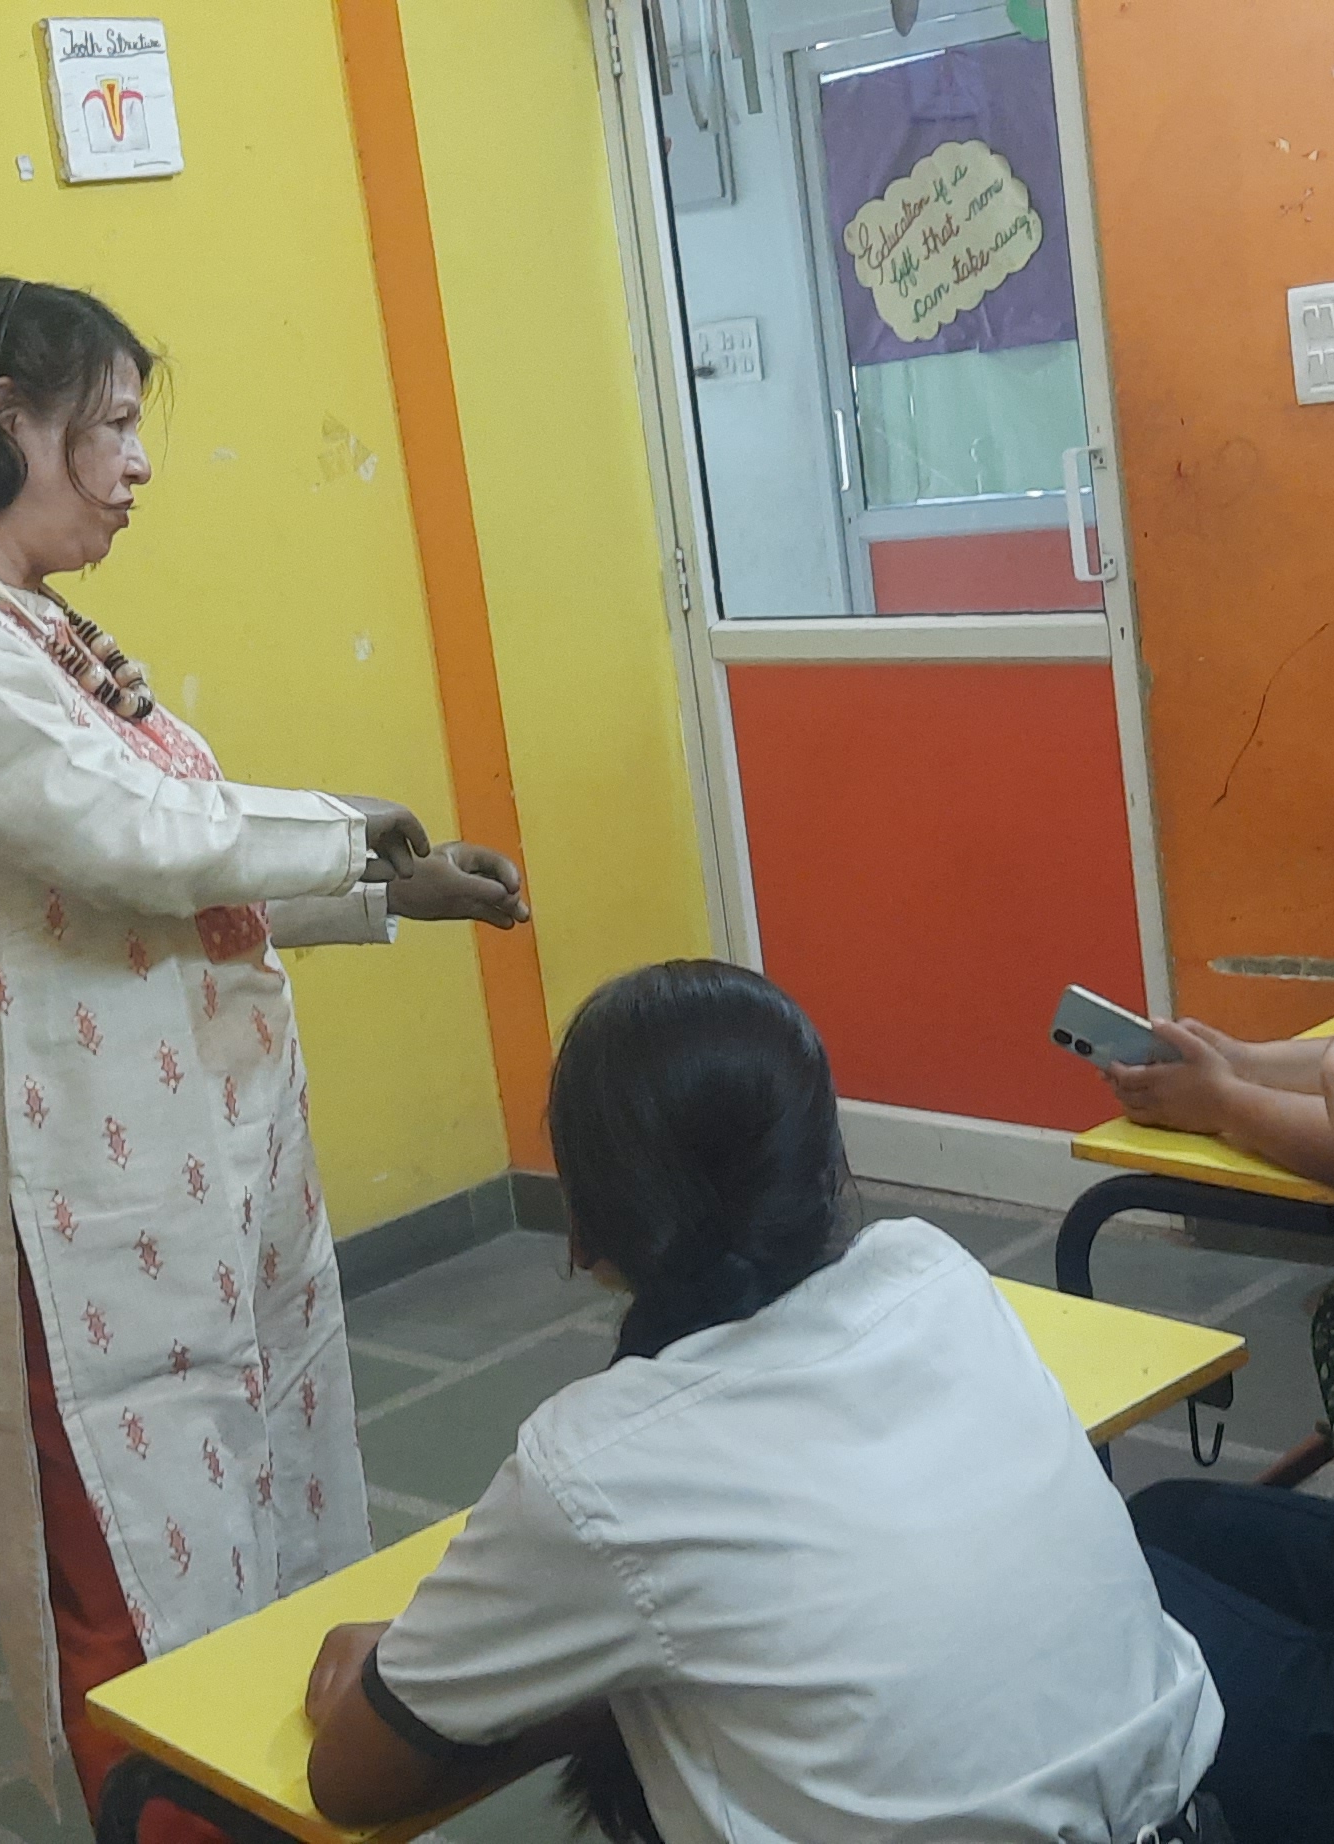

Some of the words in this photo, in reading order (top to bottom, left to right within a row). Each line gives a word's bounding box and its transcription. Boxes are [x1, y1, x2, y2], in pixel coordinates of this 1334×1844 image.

[60, 28, 102, 57] Tooth
[858, 195, 930, 286] Education
[924, 213, 960, 260] that
[913, 283, 950, 323] can
[953, 247, 990, 284] take
